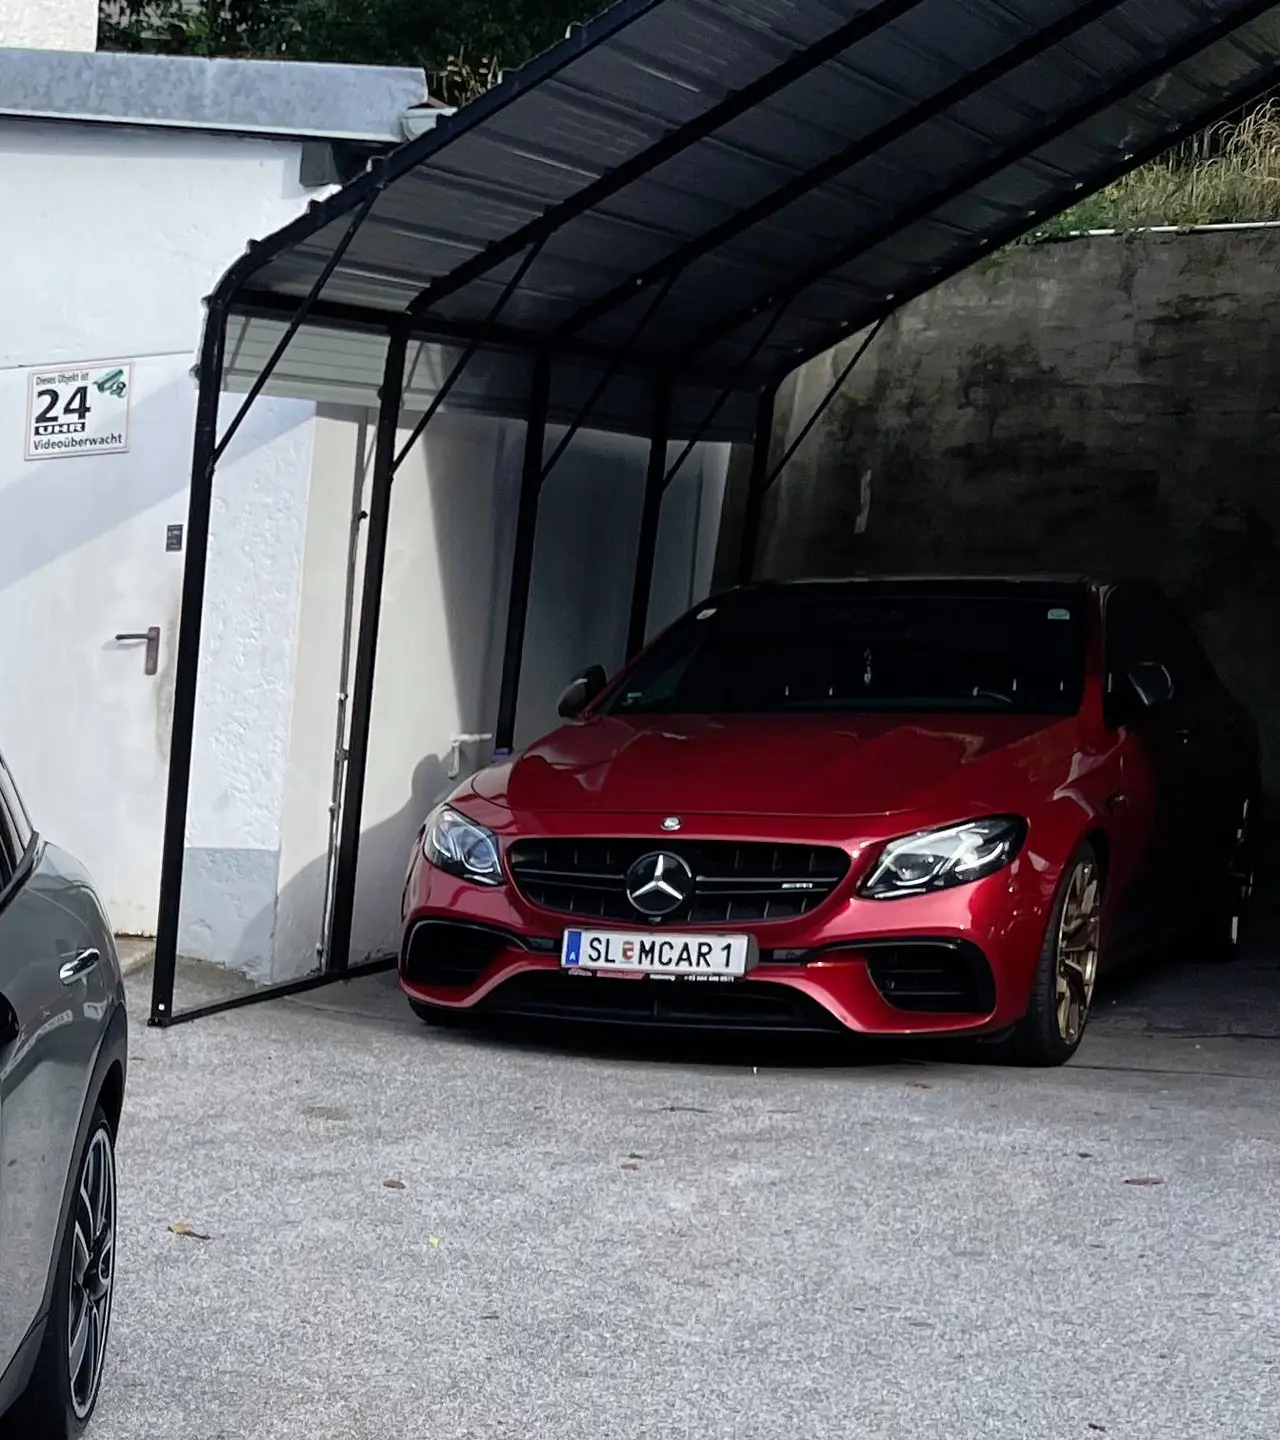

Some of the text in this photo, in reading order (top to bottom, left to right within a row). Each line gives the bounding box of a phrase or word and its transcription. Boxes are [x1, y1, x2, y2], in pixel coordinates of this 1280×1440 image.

[35, 386, 91, 424] 24
[38, 423, 83, 434] UHR
[34, 433, 122, 450] Videoüberwacht
[568, 951, 576, 961] A
[588, 936, 732, 968] SL MCAR 1
